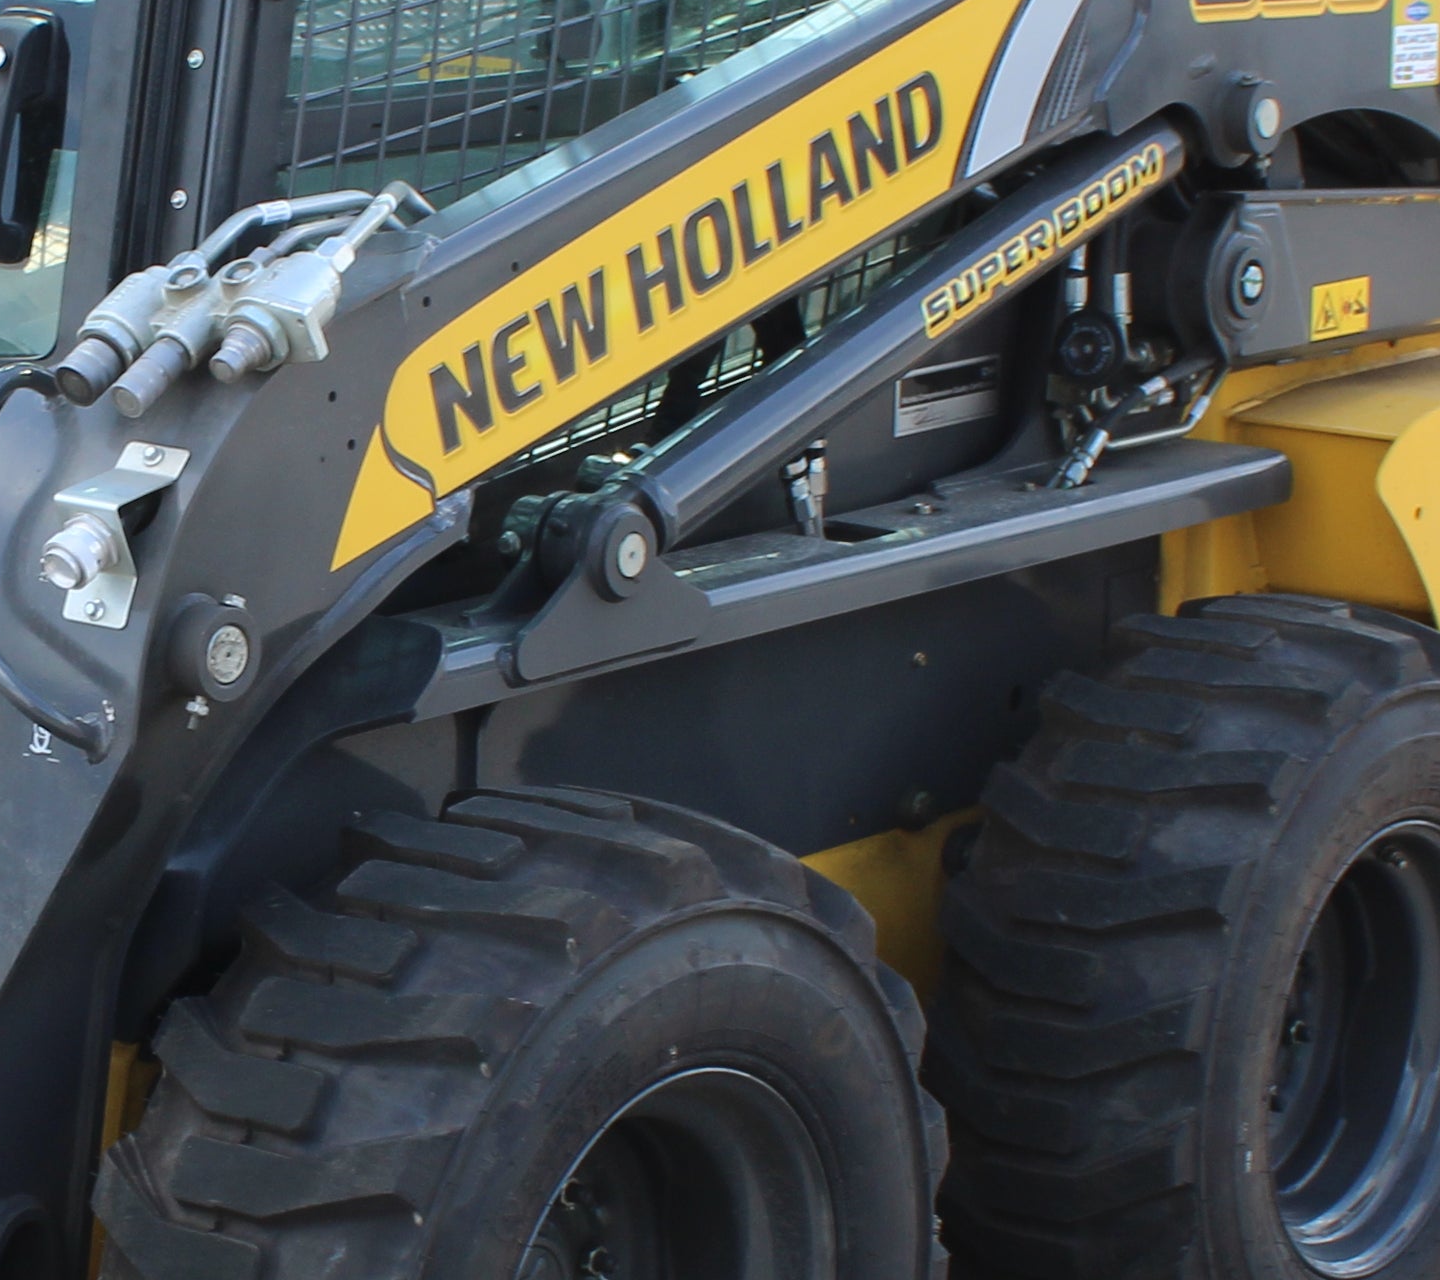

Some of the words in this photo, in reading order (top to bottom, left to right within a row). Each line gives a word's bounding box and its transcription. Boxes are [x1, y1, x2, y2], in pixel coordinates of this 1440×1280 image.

[428, 266, 609, 456] NEW
[625, 71, 943, 335] HOLLAND
[922, 220, 1055, 336] SUPER
[1053, 143, 1164, 246] BOOM
